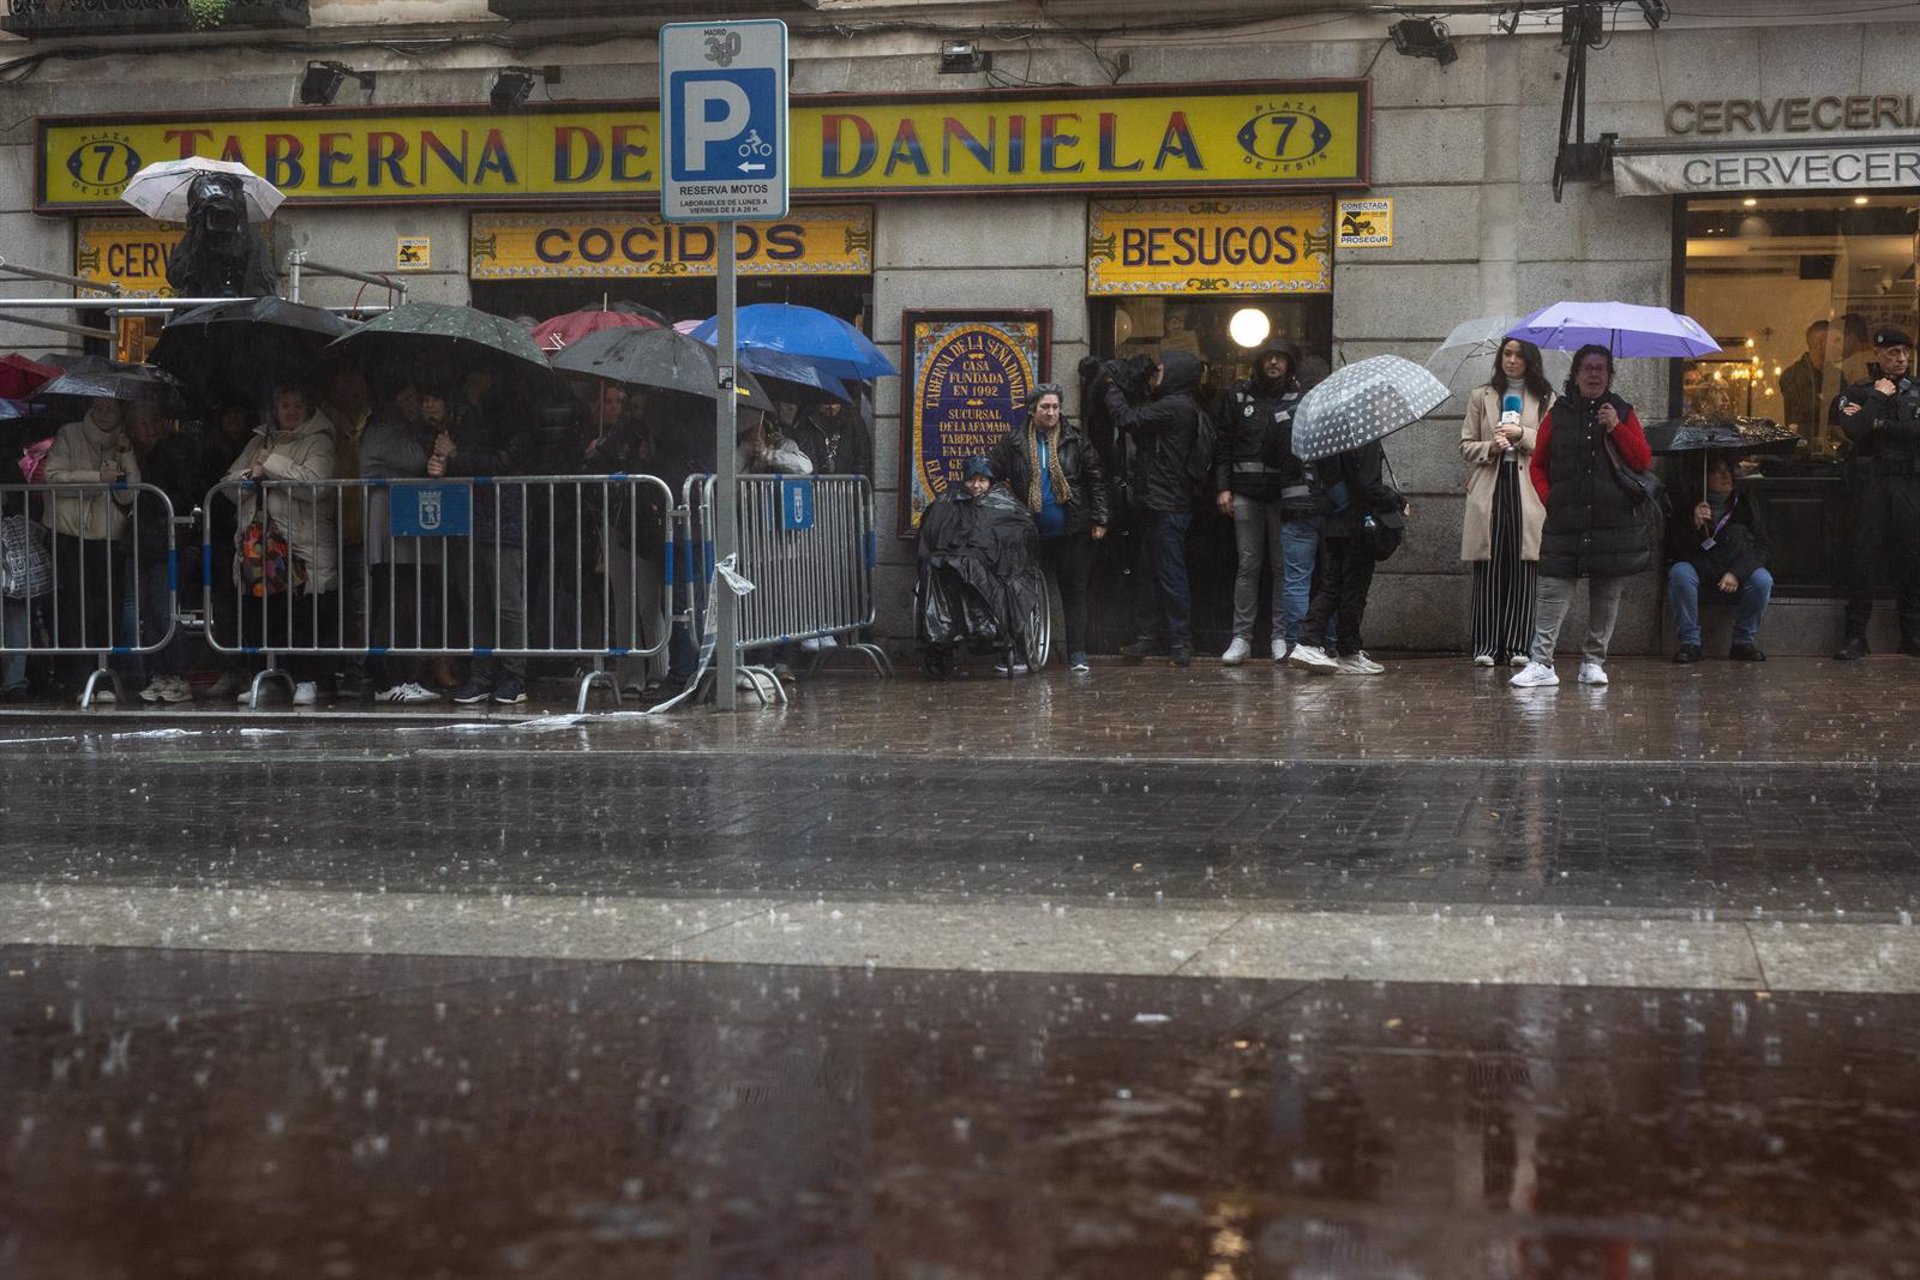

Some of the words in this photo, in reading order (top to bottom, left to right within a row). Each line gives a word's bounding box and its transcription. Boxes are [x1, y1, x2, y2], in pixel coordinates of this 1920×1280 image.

[1256, 102, 1316, 113] PLAZA
[684, 80, 751, 171] P
[81, 132, 130, 143] PLAZA
[1272, 117, 1298, 156] 7
[163, 128, 518, 189] TABERNA
[554, 124, 653, 182] DE
[821, 111, 1208, 178] DANIELA
[94, 146, 115, 181] 7
[1244, 156, 1264, 170] DE
[1272, 152, 1327, 172] JESUS
[72, 181, 88, 194] DE
[95, 183, 128, 196] JESU
[680, 185, 728, 195] RESERVA
[731, 184, 768, 194] MOTOS
[680, 199, 726, 207] LABORABLES
[1341, 202, 1388, 210] CONECTADA
[535, 223, 806, 263] COCIDOS
[1341, 235, 1388, 243] PROSEGUR
[1122, 226, 1298, 266] BESUGOS
[107, 243, 176, 277] CERV
[962, 361, 990, 371] CASA
[926, 354, 954, 410] TABERNA
[950, 340, 968, 357] DE
[967, 336, 983, 350] LA
[1006, 363, 1025, 410] DANIELA
[949, 373, 1005, 384] FUNDADA
[953, 386, 970, 396] EN
[973, 386, 999, 397] 1992
[948, 409, 1002, 420] SUCURSAL
[940, 422, 953, 432] DE
[954, 422, 966, 432] LA
[968, 422, 1011, 432] AFAMADA
[941, 434, 984, 445] TABERNA
[942, 446, 958, 456] EN
[959, 446, 971, 456] LA
